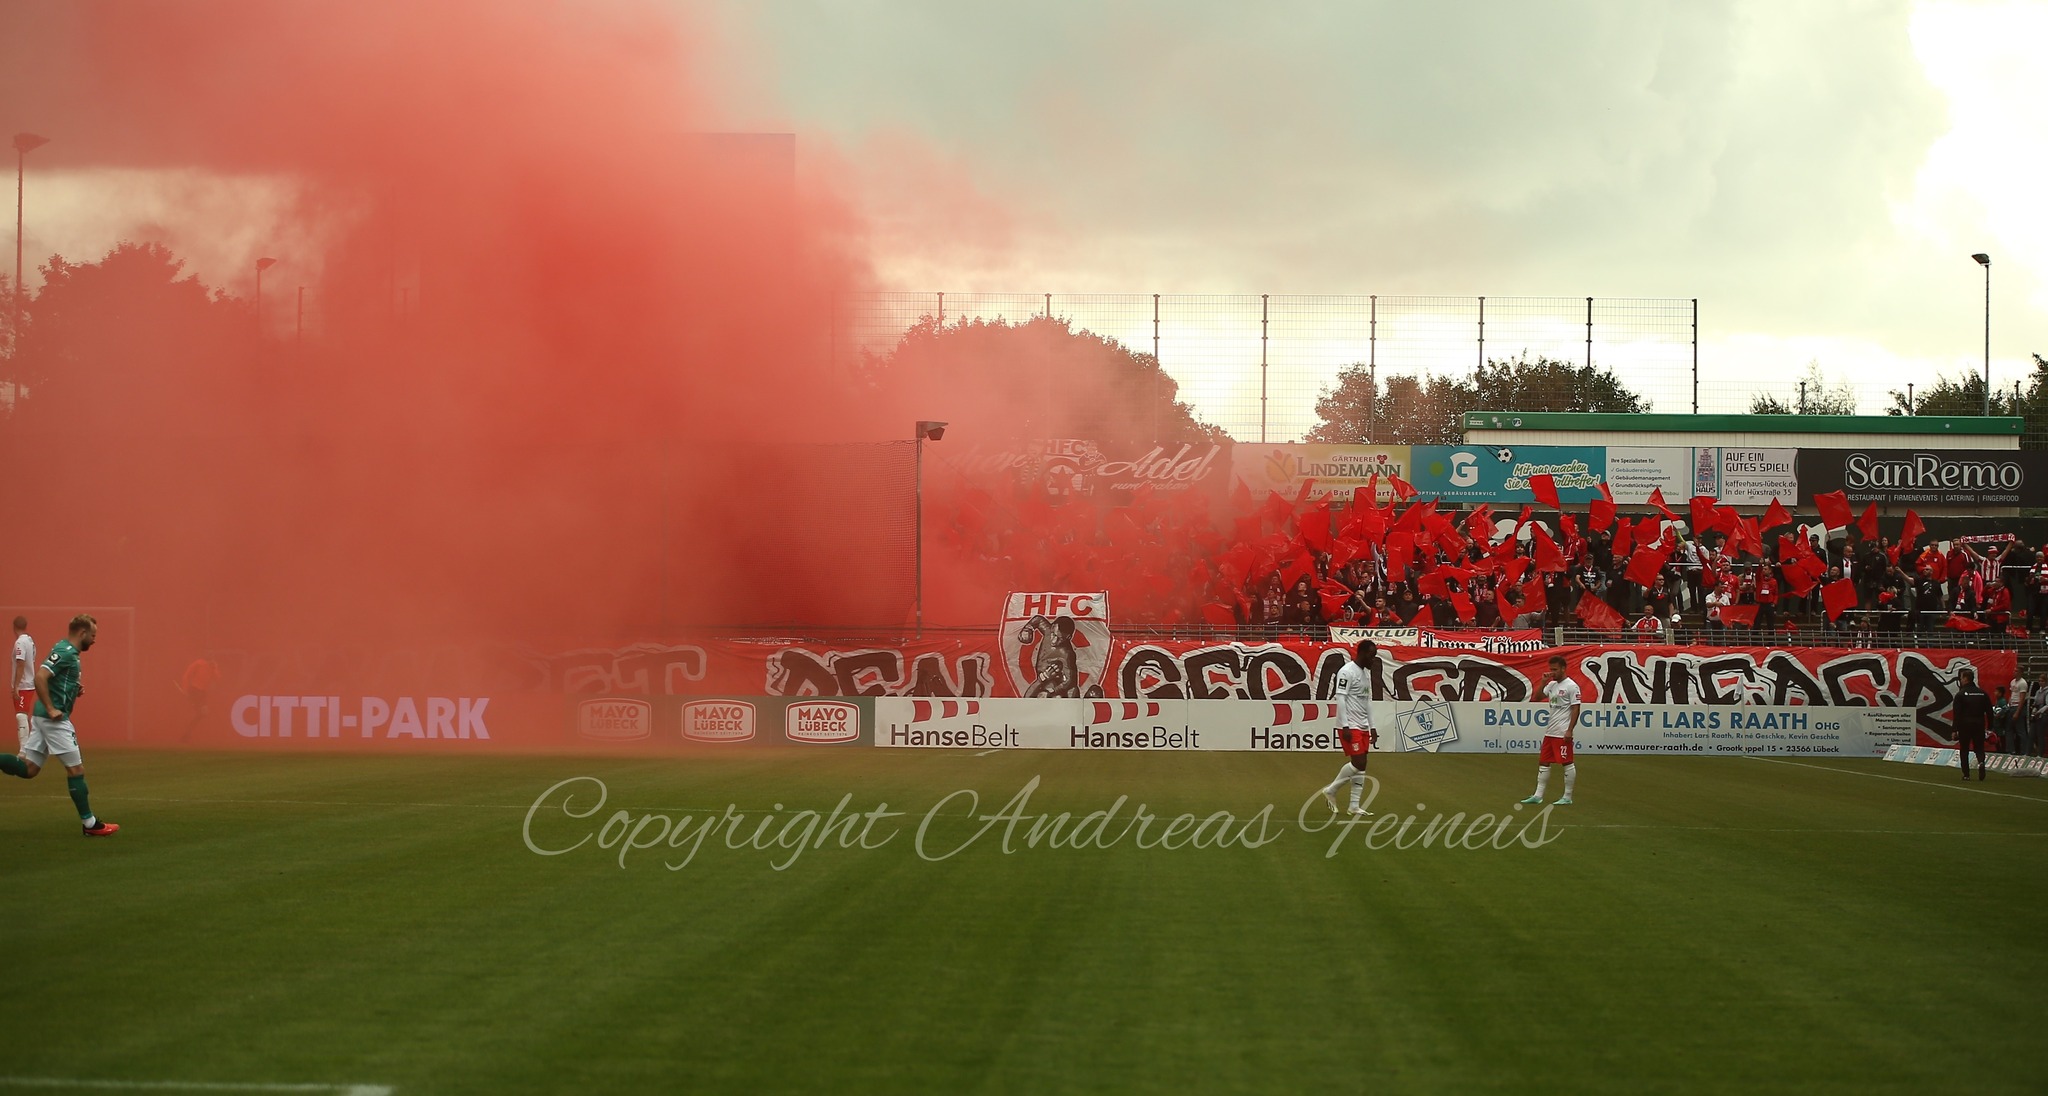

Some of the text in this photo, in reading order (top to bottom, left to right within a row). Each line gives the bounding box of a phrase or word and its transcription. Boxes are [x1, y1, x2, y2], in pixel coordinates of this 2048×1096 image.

[1097, 444, 1221, 481] Adel
[1332, 455, 1376, 463] GÄRTNEREI
[1726, 452, 1764, 462] AUF EIN
[1449, 452, 1479, 487] G
[1513, 459, 1588, 476] Mit uns machen
[1726, 463, 1789, 472] GUTES SPIEL!
[1847, 455, 2021, 488] SanRemo
[1504, 477, 1521, 490] Sie
[1725, 480, 1797, 488] kaffeehaus-lübeck.de
[1783, 488, 1791, 496] 35
[1893, 494, 1938, 502] FIRMENEVENTS
[1945, 494, 1975, 502] CATERING
[1023, 594, 1095, 617] HFC
[1339, 627, 1418, 637] FANCLUB
[231, 694, 490, 739] CITTI-PARK
[590, 706, 639, 719] MAYO
[694, 707, 743, 720] MAYO
[798, 708, 847, 721] MAYO
[1484, 705, 1840, 730] BAUGCHÄFT LARS RAATH OHG
[694, 720, 743, 731] LÜBECK
[798, 721, 847, 732] LÜBECK
[890, 724, 1019, 747] HanseBelt
[1070, 725, 1200, 748] HanseBelt
[1663, 731, 1693, 739] Inhaber:
[1711, 732, 1734, 740] Raath,
[1755, 732, 1787, 740] Geschke,
[1484, 739, 1502, 749] Tel.
[1597, 743, 1704, 752] www.maurer-raath.de
[1767, 745, 1777, 753] 15
[1786, 745, 1840, 753] 23566 Lübeck
[1560, 745, 1568, 756] 22
